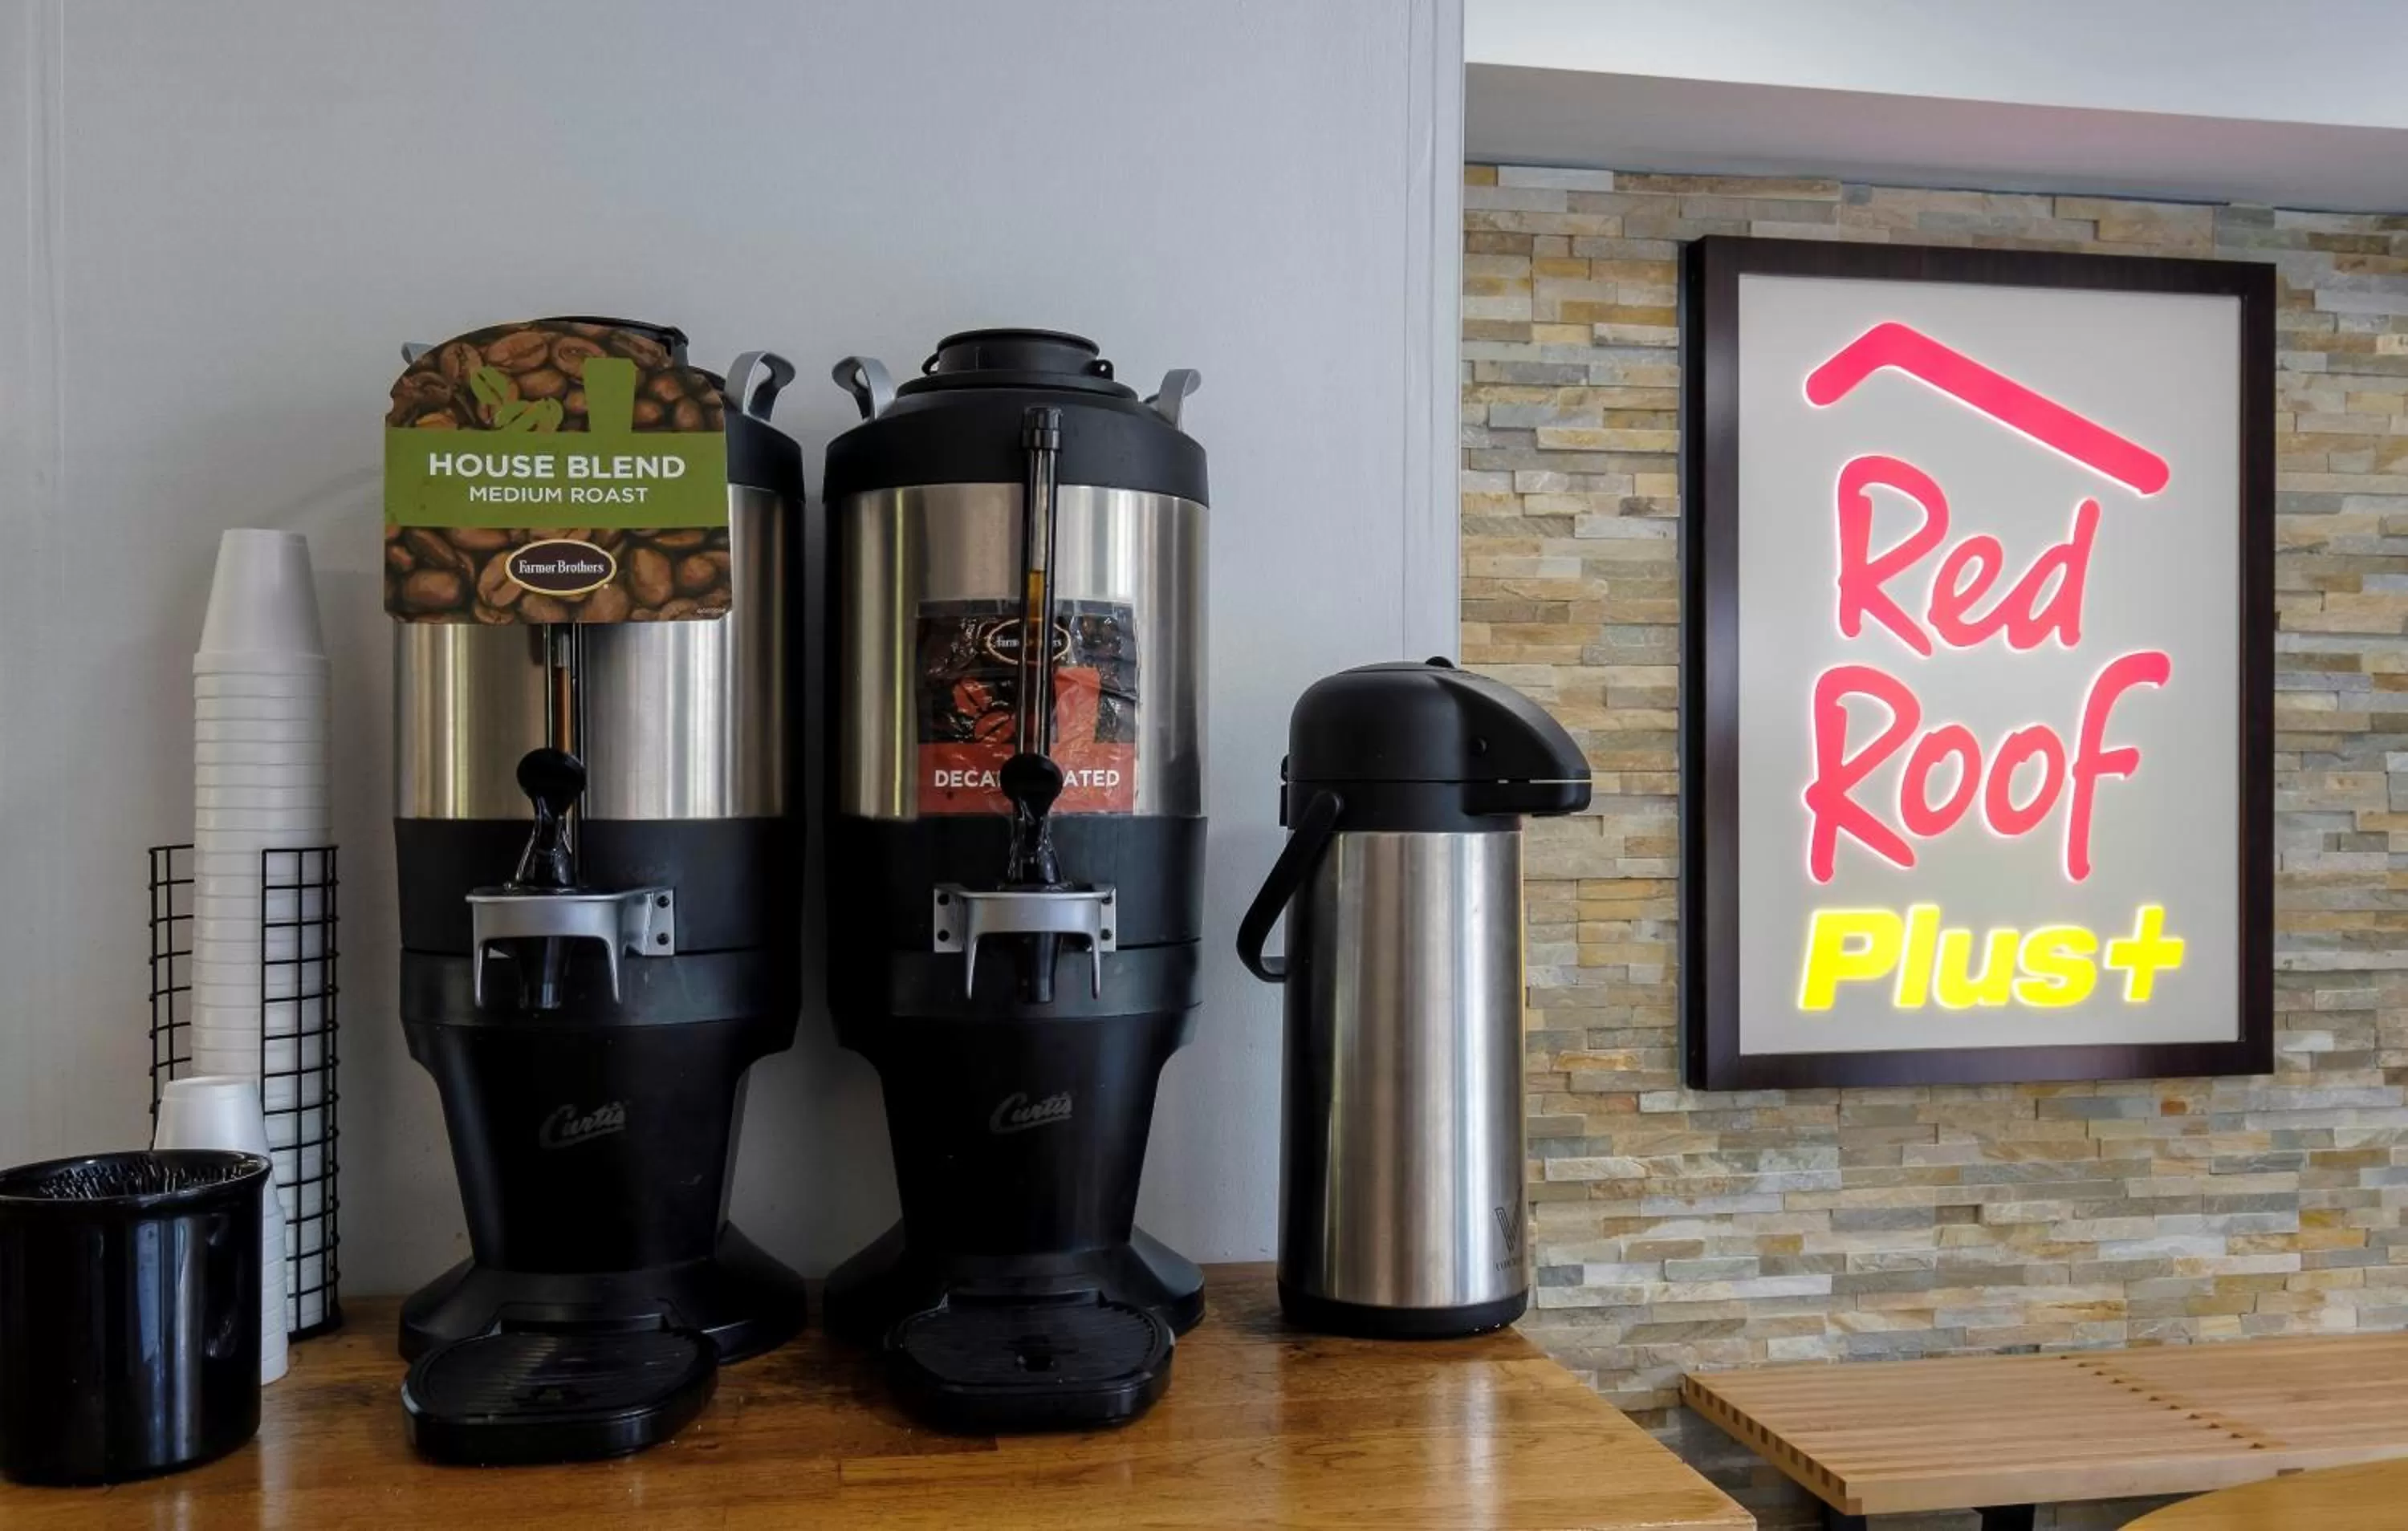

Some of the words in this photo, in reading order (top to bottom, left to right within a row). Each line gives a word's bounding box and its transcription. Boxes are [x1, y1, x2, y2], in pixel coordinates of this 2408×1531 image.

[429, 453, 555, 479] HOUSE
[567, 455, 685, 479] BLEND
[469, 486, 563, 503] MEDIUM
[571, 487, 649, 504] ROAST
[519, 559, 556, 574] Farmer
[556, 559, 604, 574] Brothers
[1837, 455, 2101, 657] Red
[934, 769, 1120, 788] DECAATED
[1802, 650, 2171, 883] Roof
[1798, 904, 2184, 1009] Plus+
[539, 1100, 625, 1150] Curtis
[989, 1091, 1072, 1135] Curtis
